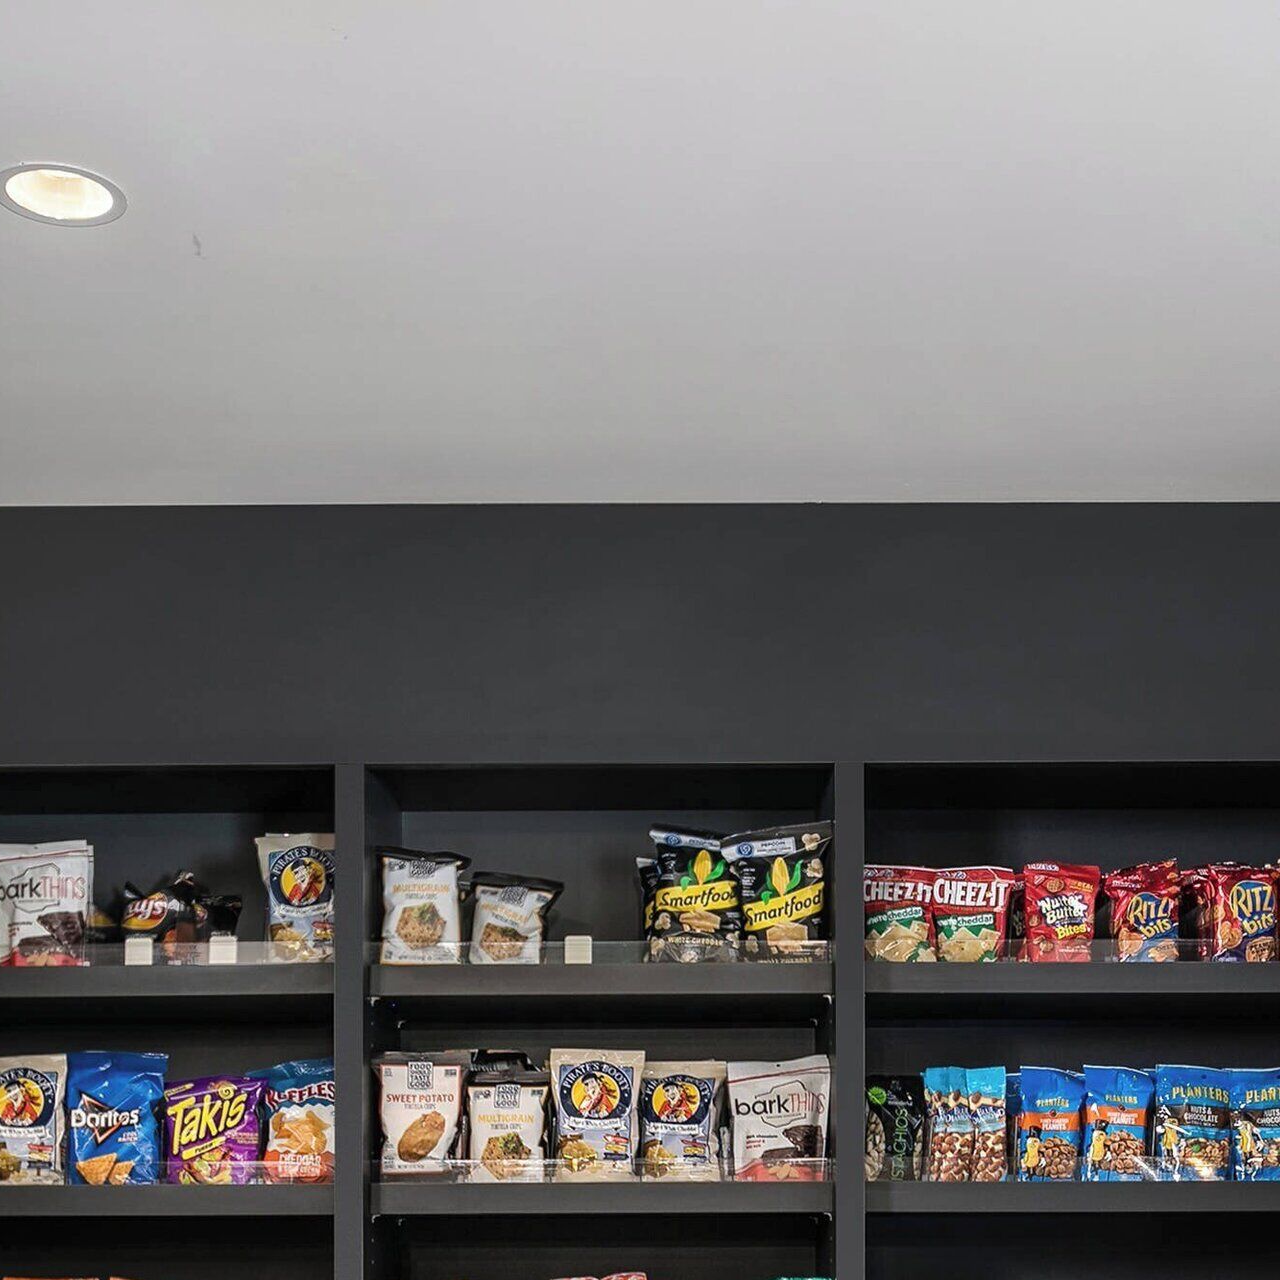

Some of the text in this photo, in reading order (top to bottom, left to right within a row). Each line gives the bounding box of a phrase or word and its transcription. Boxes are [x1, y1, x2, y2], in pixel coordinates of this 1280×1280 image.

[863, 879, 934, 904] CHEEZ-IT
[933, 878, 1009, 907] CHEEZ-IT
[1228, 884, 1276, 920] RITZ
[745, 892, 822, 927] Smartfood
[1036, 894, 1083, 914] Nutter
[1045, 903, 1089, 925] Butter
[1055, 923, 1088, 940] Bites
[1241, 912, 1276, 935] bits
[409, 1063, 432, 1071] FOOD
[409, 1080, 432, 1089] GOOD
[562, 1062, 632, 1095] PIRATE'S BOOTY
[265, 1081, 335, 1110] RUFFLES
[386, 1093, 455, 1104] SWEET POTATO
[733, 1091, 826, 1117] barkTHINS
[1171, 1085, 1230, 1104] PLANTERS
[70, 1108, 140, 1129] Doritos
[477, 1114, 535, 1124] MULTIGRAIN
[1183, 1113, 1219, 1124] CHOCOLATE
[1190, 1105, 1207, 1115] NUTS
[1263, 1108, 1280, 1117] NUTS
[166, 1092, 248, 1156] Takis
